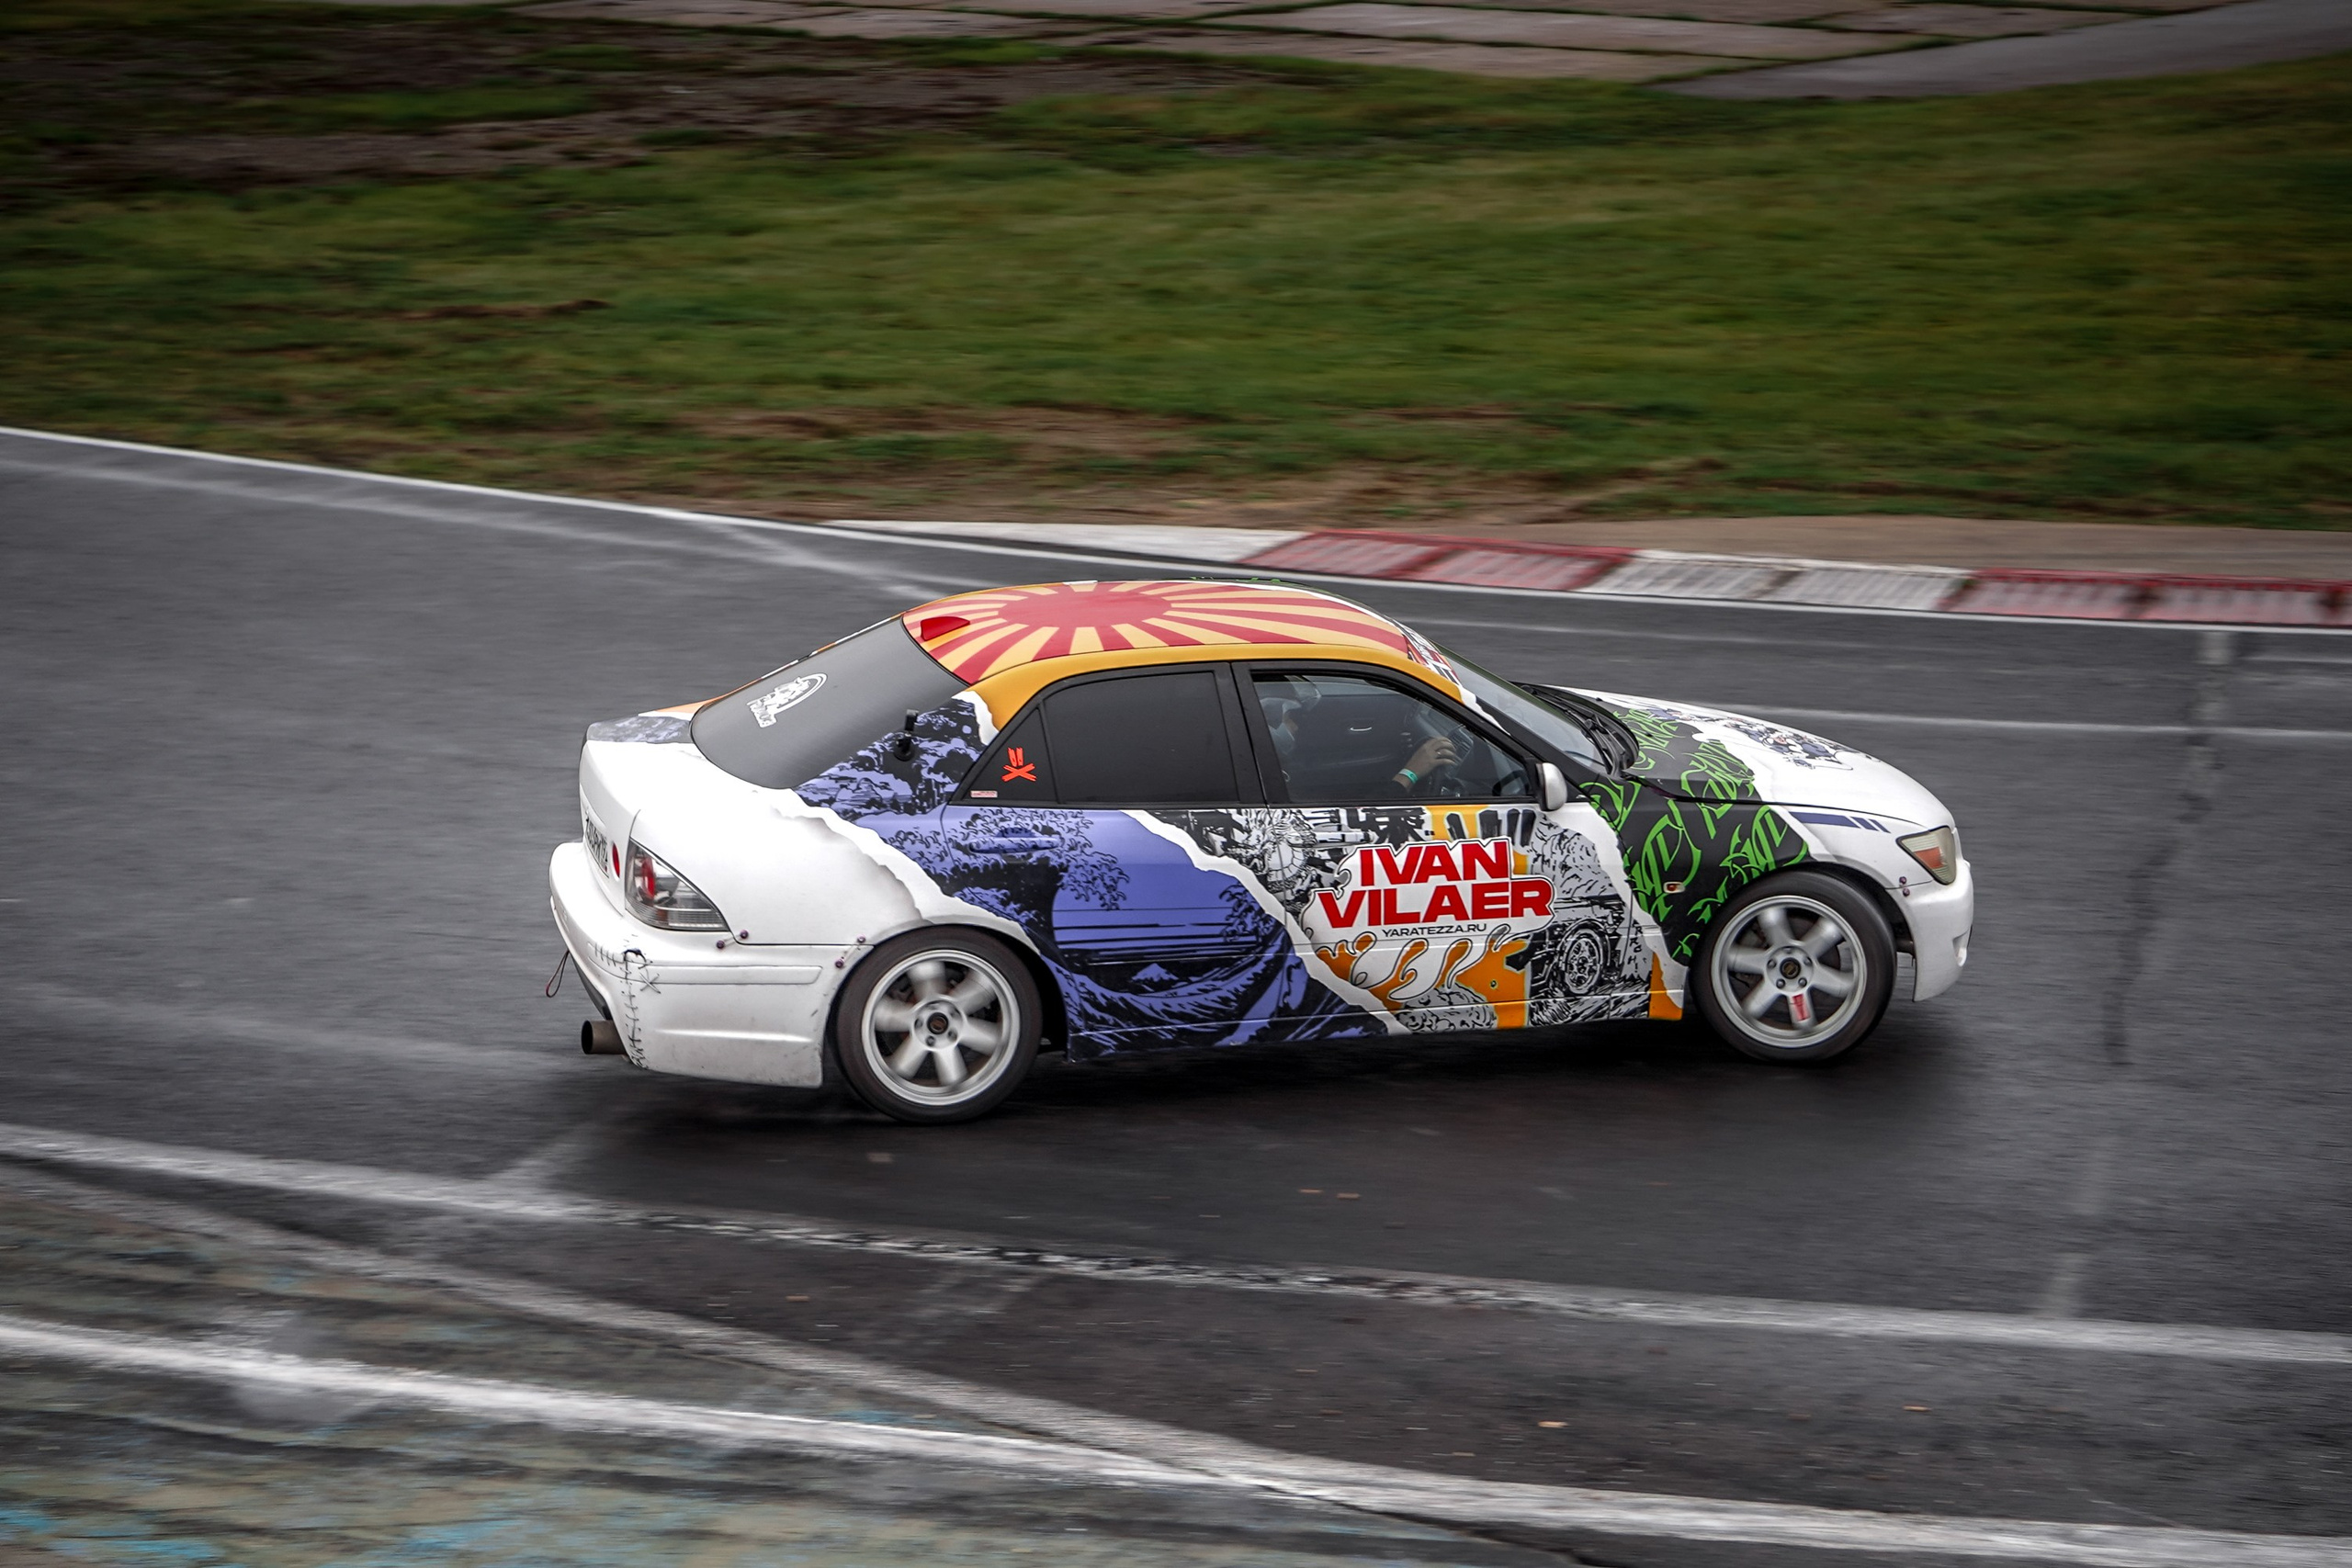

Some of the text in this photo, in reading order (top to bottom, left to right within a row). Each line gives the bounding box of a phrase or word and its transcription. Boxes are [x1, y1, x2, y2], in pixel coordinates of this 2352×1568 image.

[1360, 841, 1510, 886] IVAN
[1317, 879, 1553, 929] VILAER
[1381, 923, 1487, 938] YARATEZZA.RU
